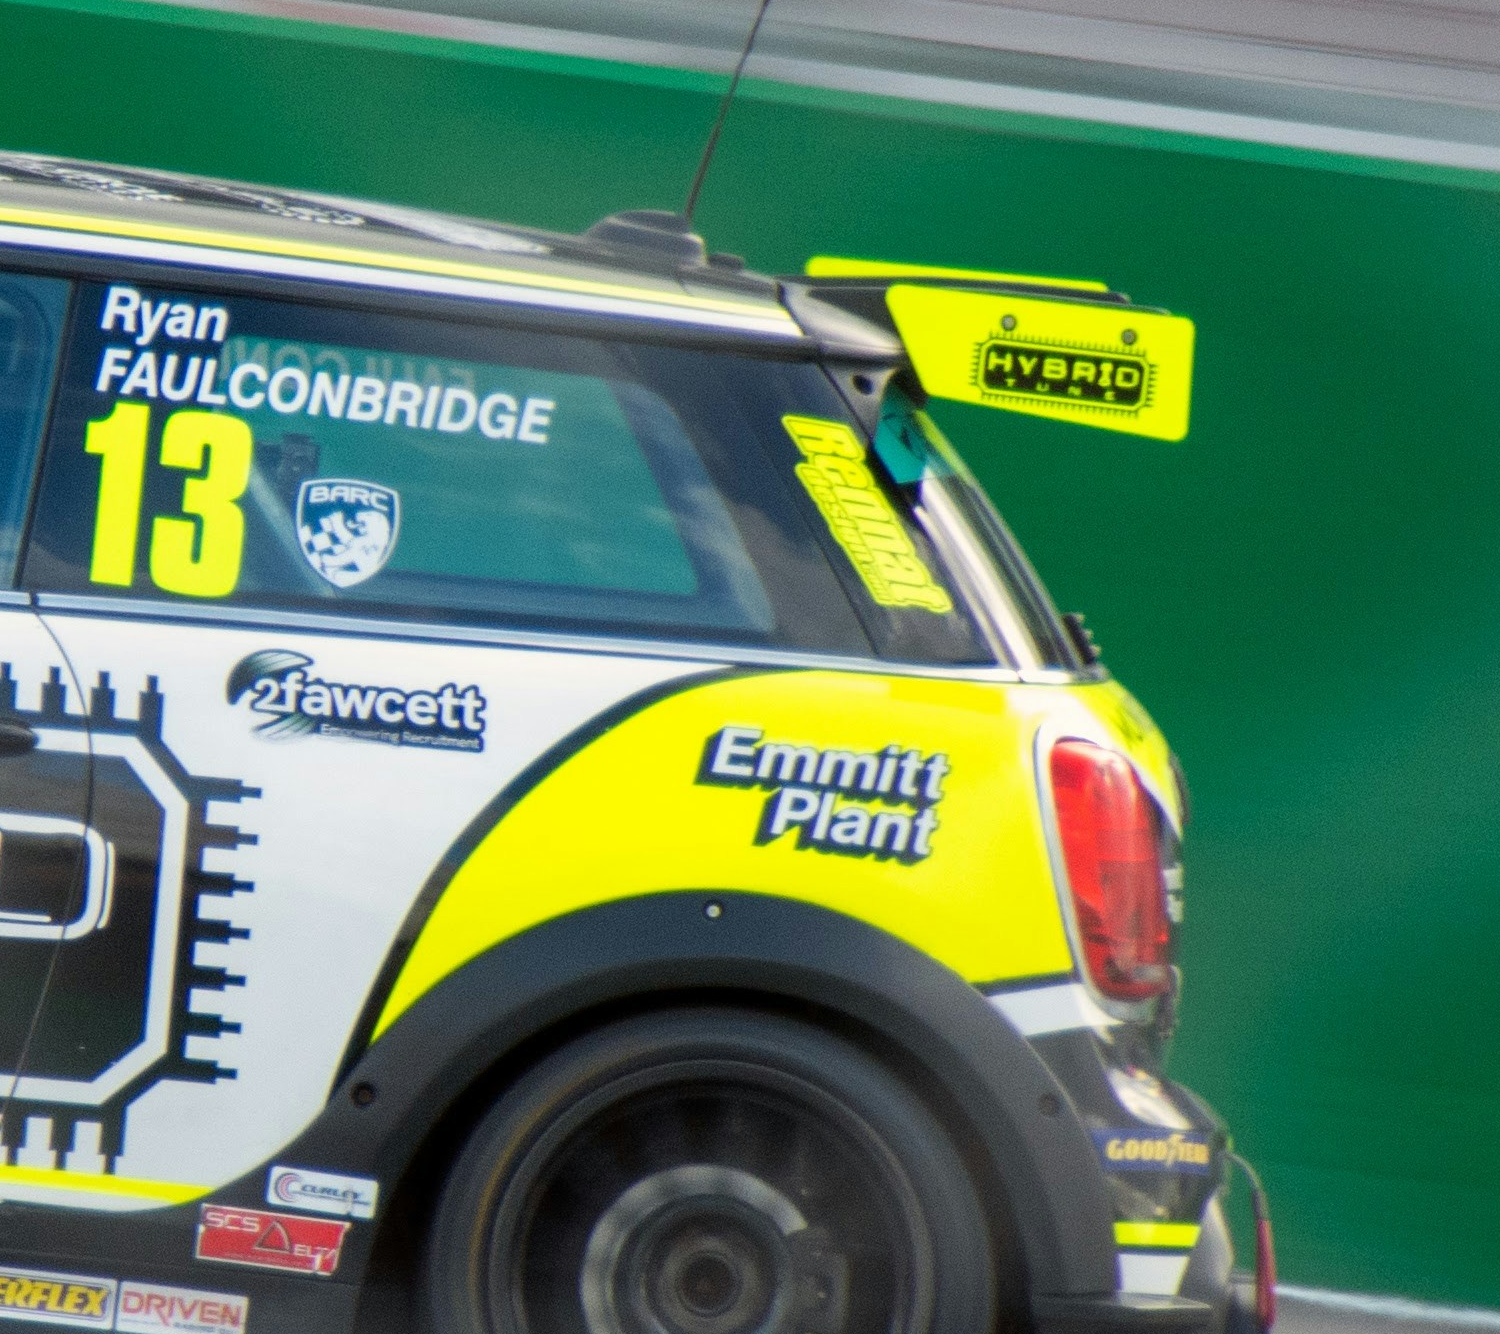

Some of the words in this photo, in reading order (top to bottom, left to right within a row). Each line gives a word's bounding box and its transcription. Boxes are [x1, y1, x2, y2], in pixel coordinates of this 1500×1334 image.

[100, 285, 228, 345] Ryan
[96, 349, 556, 444] FAULCONBRIDGE
[988, 351, 1140, 388] HYBRID
[85, 401, 254, 598] 13
[309, 486, 389, 512] BARC
[253, 670, 485, 732] 2fawcett
[702, 726, 951, 805] Emmitt
[762, 786, 939, 861] Plant
[205, 1210, 260, 1233] SCS
[122, 1290, 240, 1328] DRIVEN
